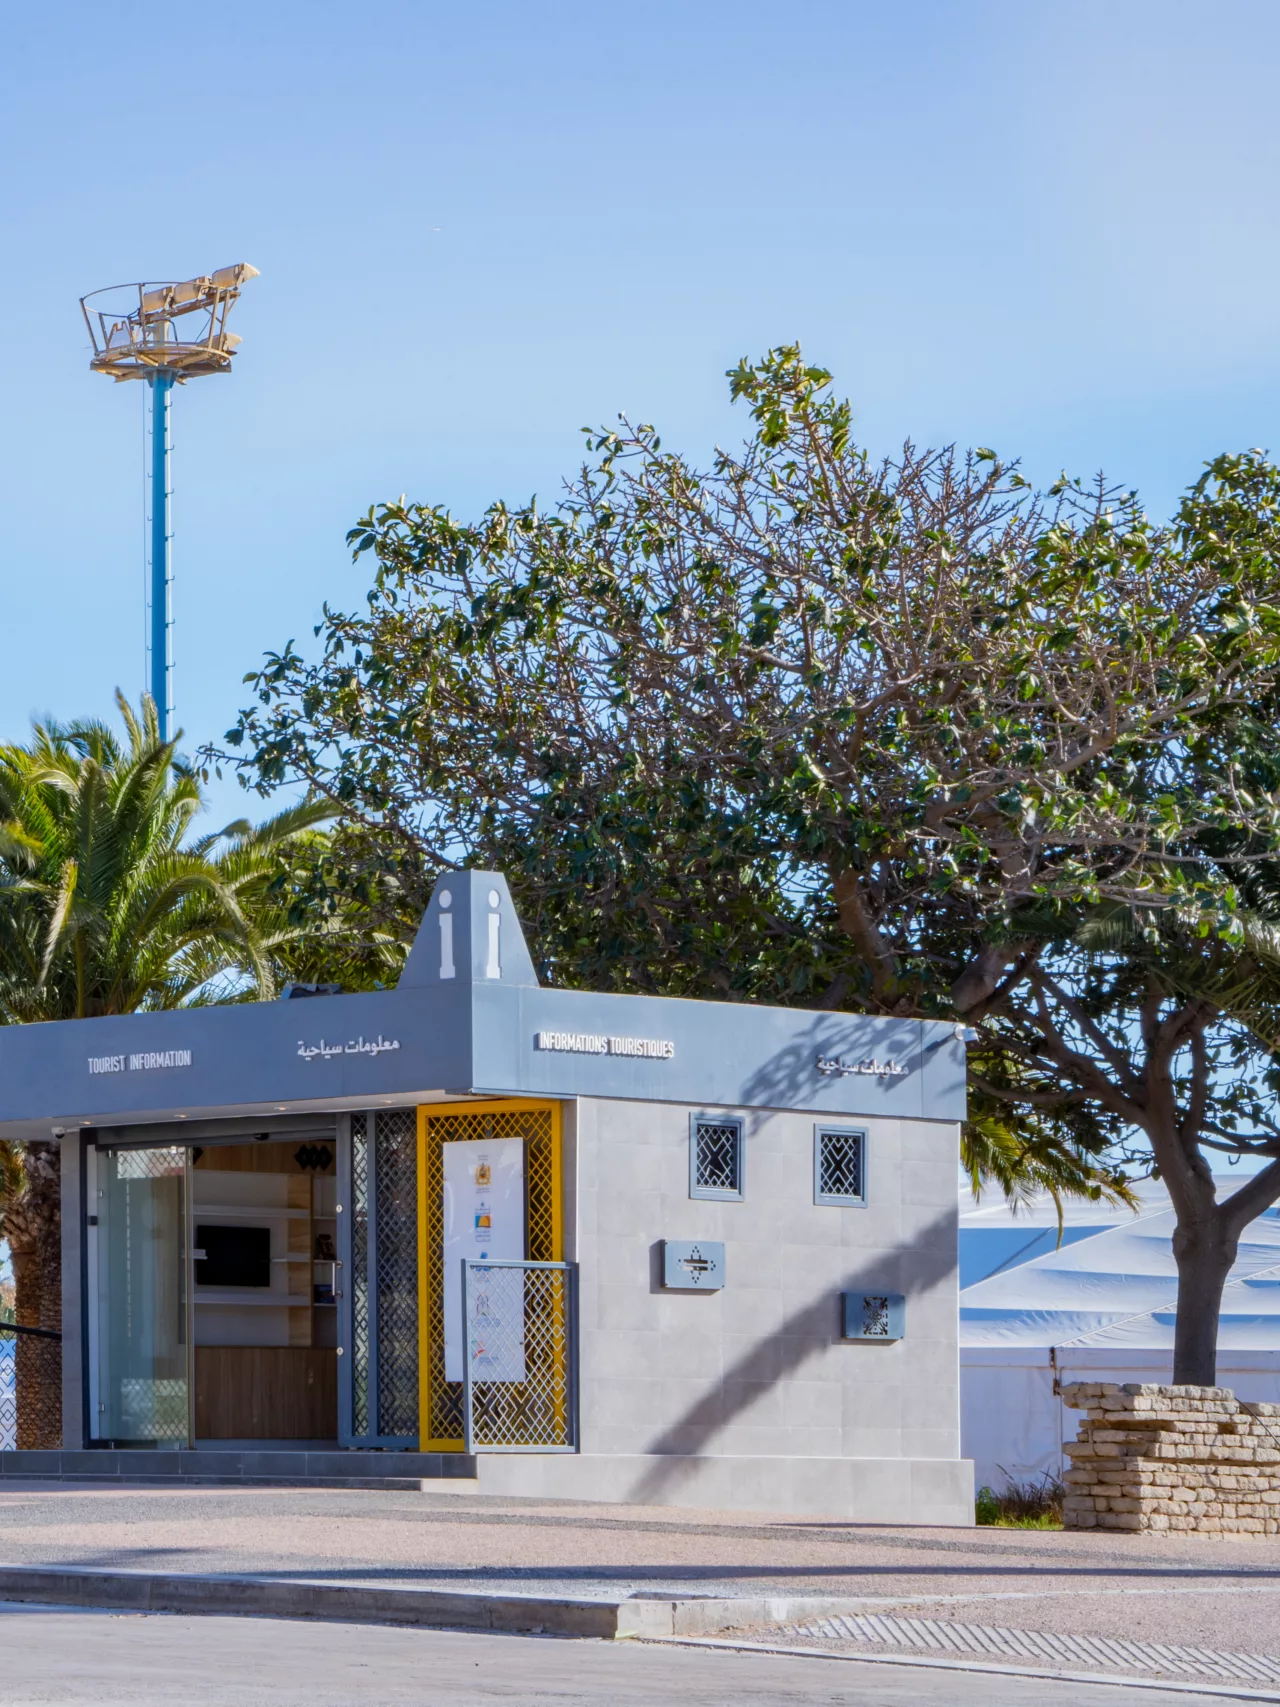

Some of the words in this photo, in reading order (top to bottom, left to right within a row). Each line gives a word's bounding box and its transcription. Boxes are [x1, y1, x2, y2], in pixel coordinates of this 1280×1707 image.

[297, 1040, 343, 1061] سياحية
[344, 1035, 401, 1056] معلومات
[538, 1031, 608, 1053] INFORMATIONS
[609, 1036, 674, 1058] TOURISTIQUES
[88, 1055, 126, 1074] TOURIST
[129, 1049, 192, 1070] INFORMATION
[816, 1055, 860, 1076] سياحية
[860, 1058, 909, 1078] معلومات
